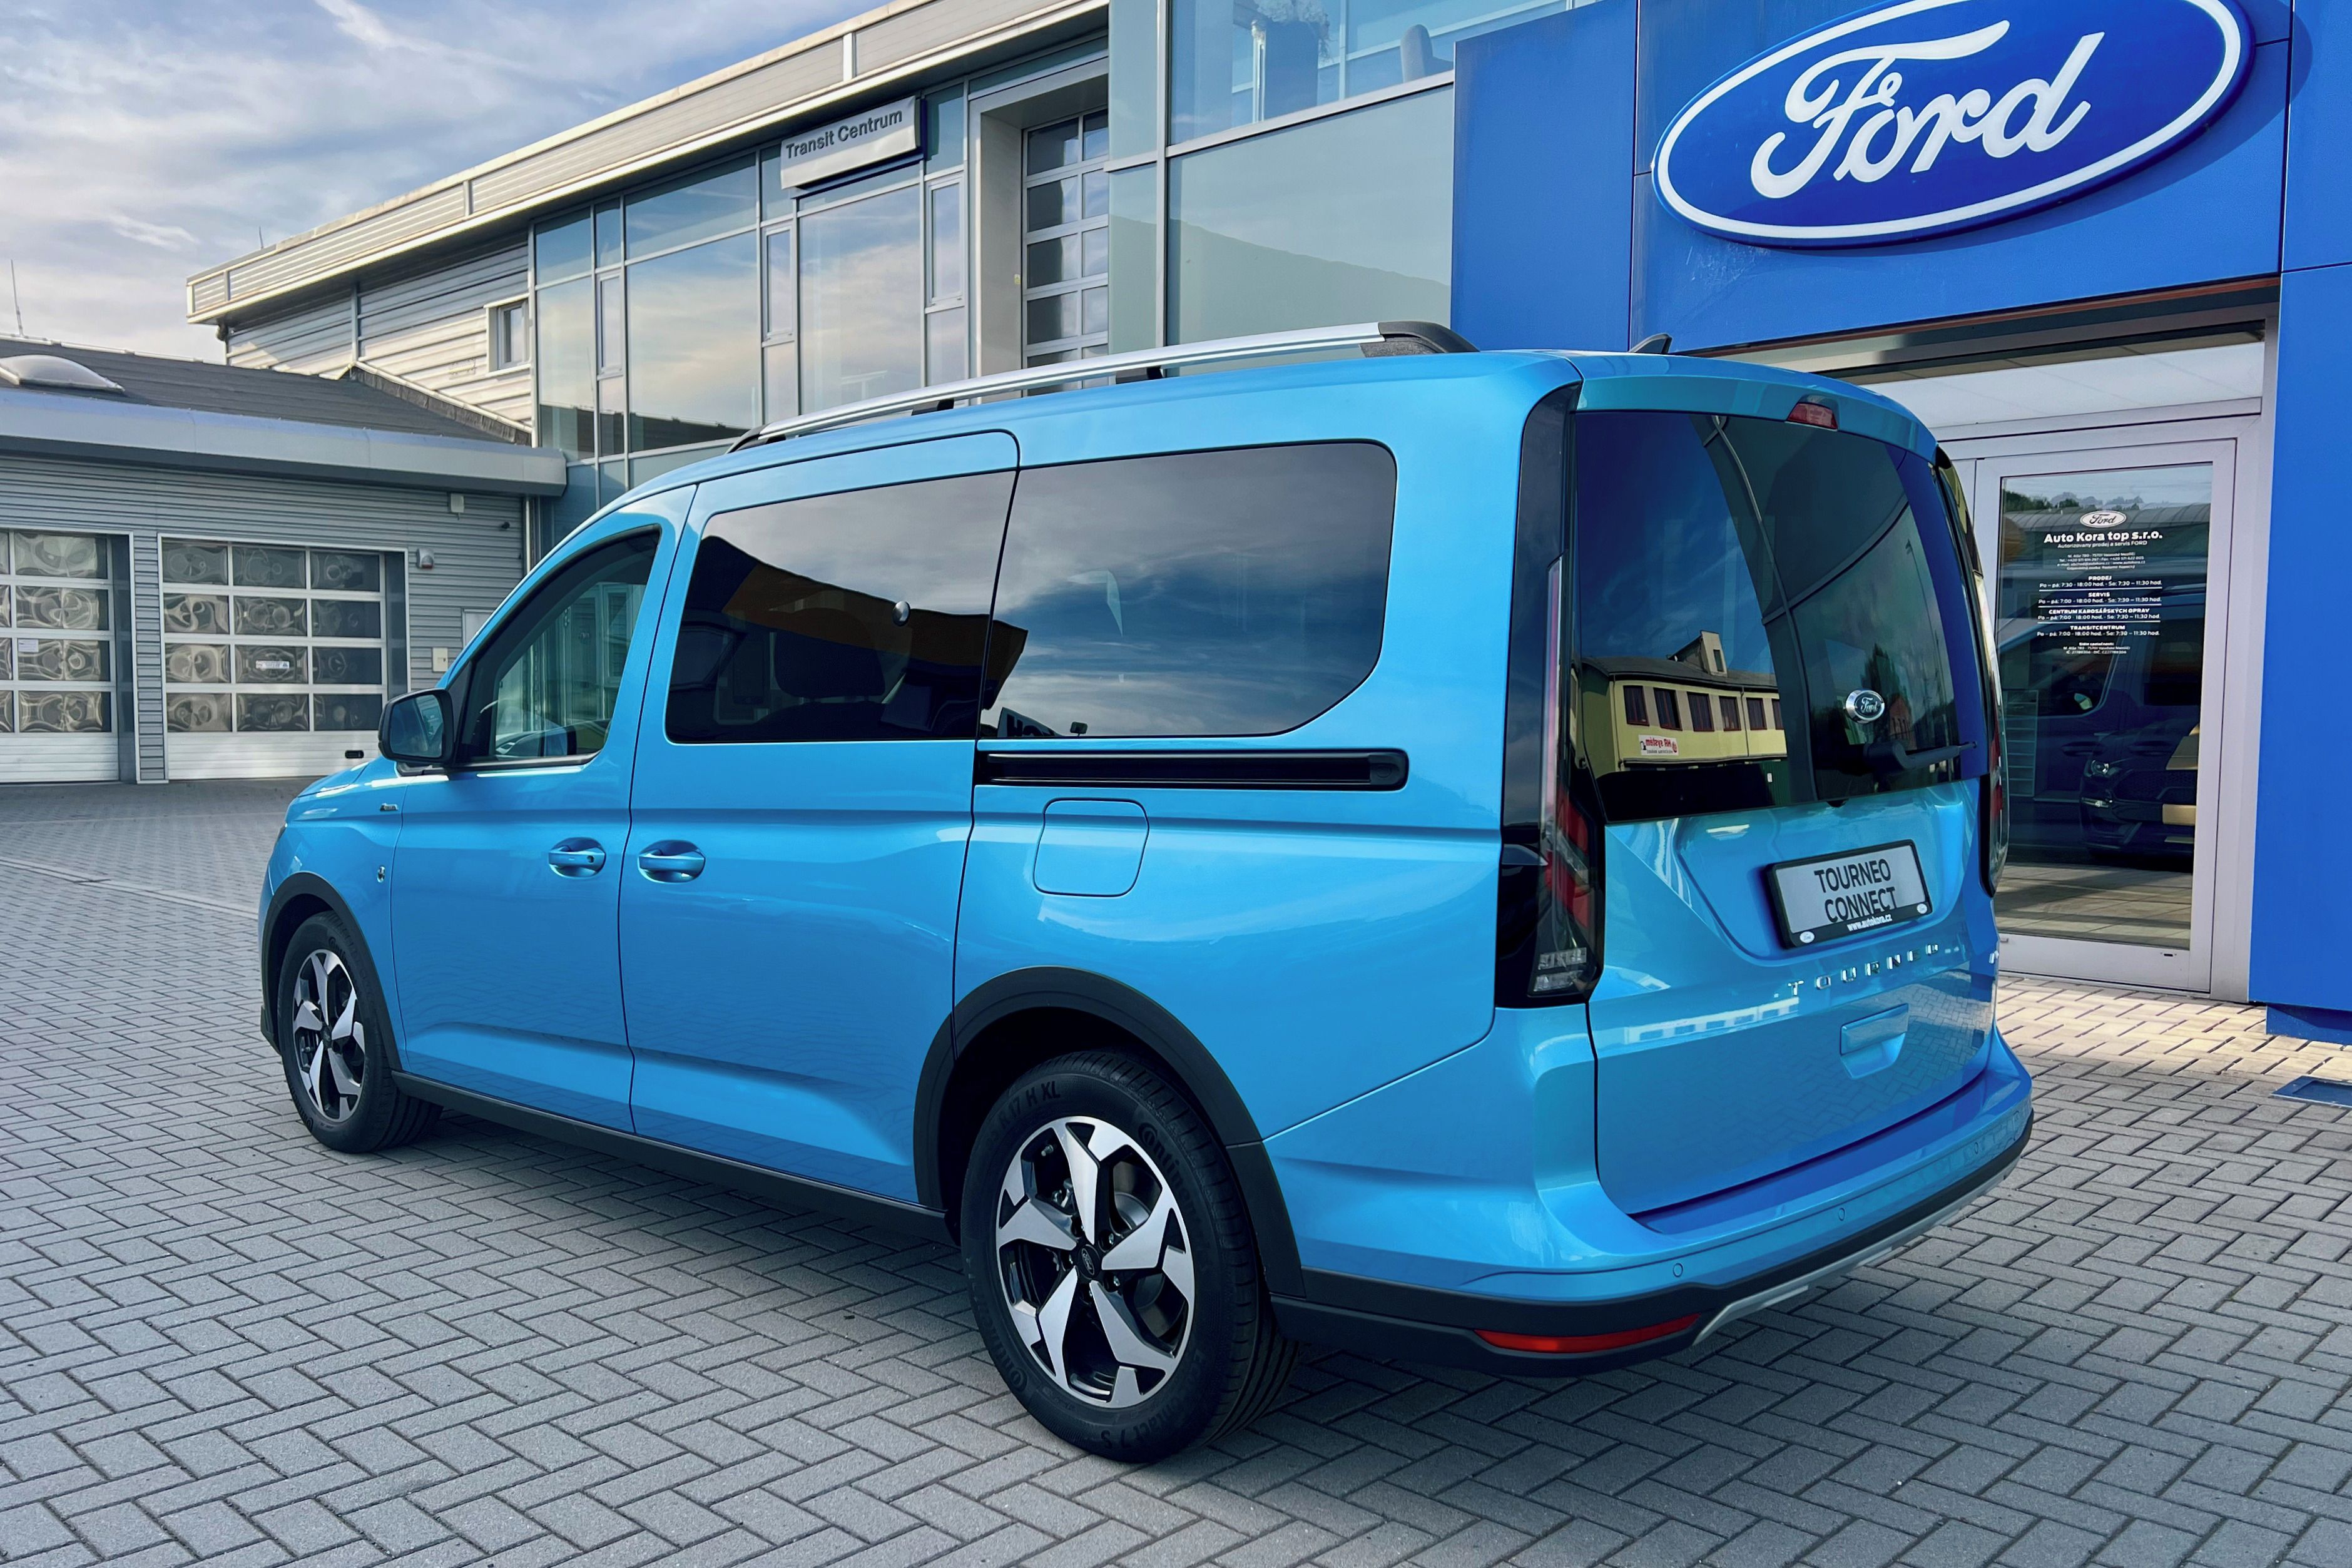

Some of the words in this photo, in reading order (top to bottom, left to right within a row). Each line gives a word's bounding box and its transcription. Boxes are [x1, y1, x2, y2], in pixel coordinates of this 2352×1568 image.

[1751, 20, 2104, 199] Ford
[786, 130, 835, 159] Transit
[838, 109, 902, 142] Centrum
[2089, 513, 2117, 524] Ford
[2044, 533, 2074, 543] Auto
[2077, 532, 2105, 542] Kora
[2107, 531, 2129, 542] top
[2131, 531, 2163, 539] s.r.o.
[1860, 696, 1878, 713] Ford
[1814, 858, 1891, 893] TOURNEO
[1825, 887, 1898, 923] CONNECT
[1025, 1087, 1038, 1107] H
[1041, 1081, 1061, 1101] XL
